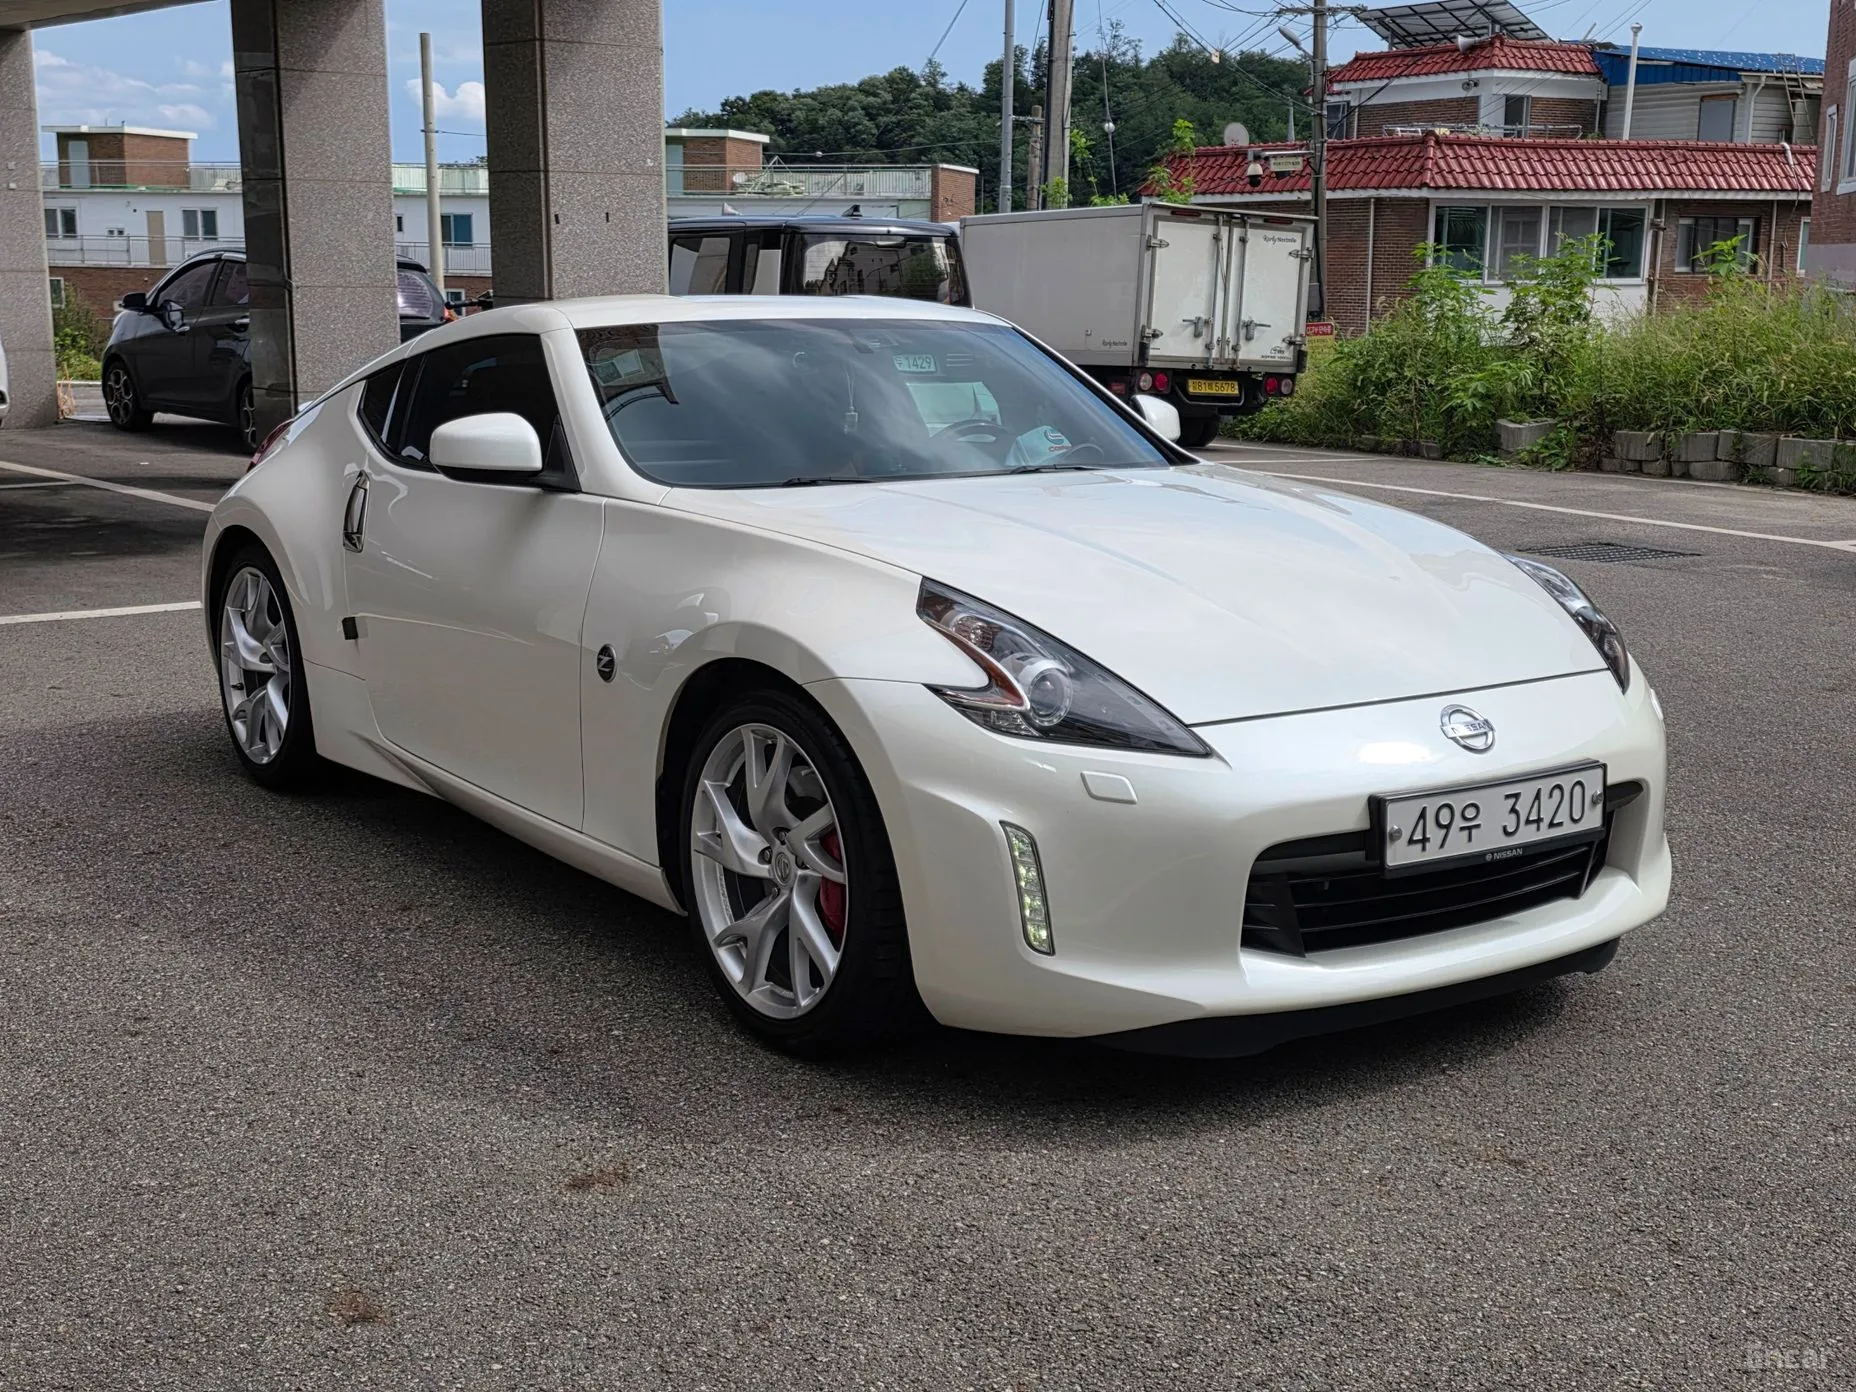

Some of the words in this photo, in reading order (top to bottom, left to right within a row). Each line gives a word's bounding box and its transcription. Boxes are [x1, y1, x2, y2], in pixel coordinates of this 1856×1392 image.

[905, 356, 932, 370] 1429
[1214, 382, 1236, 392] 5678
[1451, 720, 1492, 734] NSSAN
[1407, 802, 1482, 852] 49우
[1502, 780, 1586, 837] 3420
[1493, 848, 1523, 860] NISSAN
